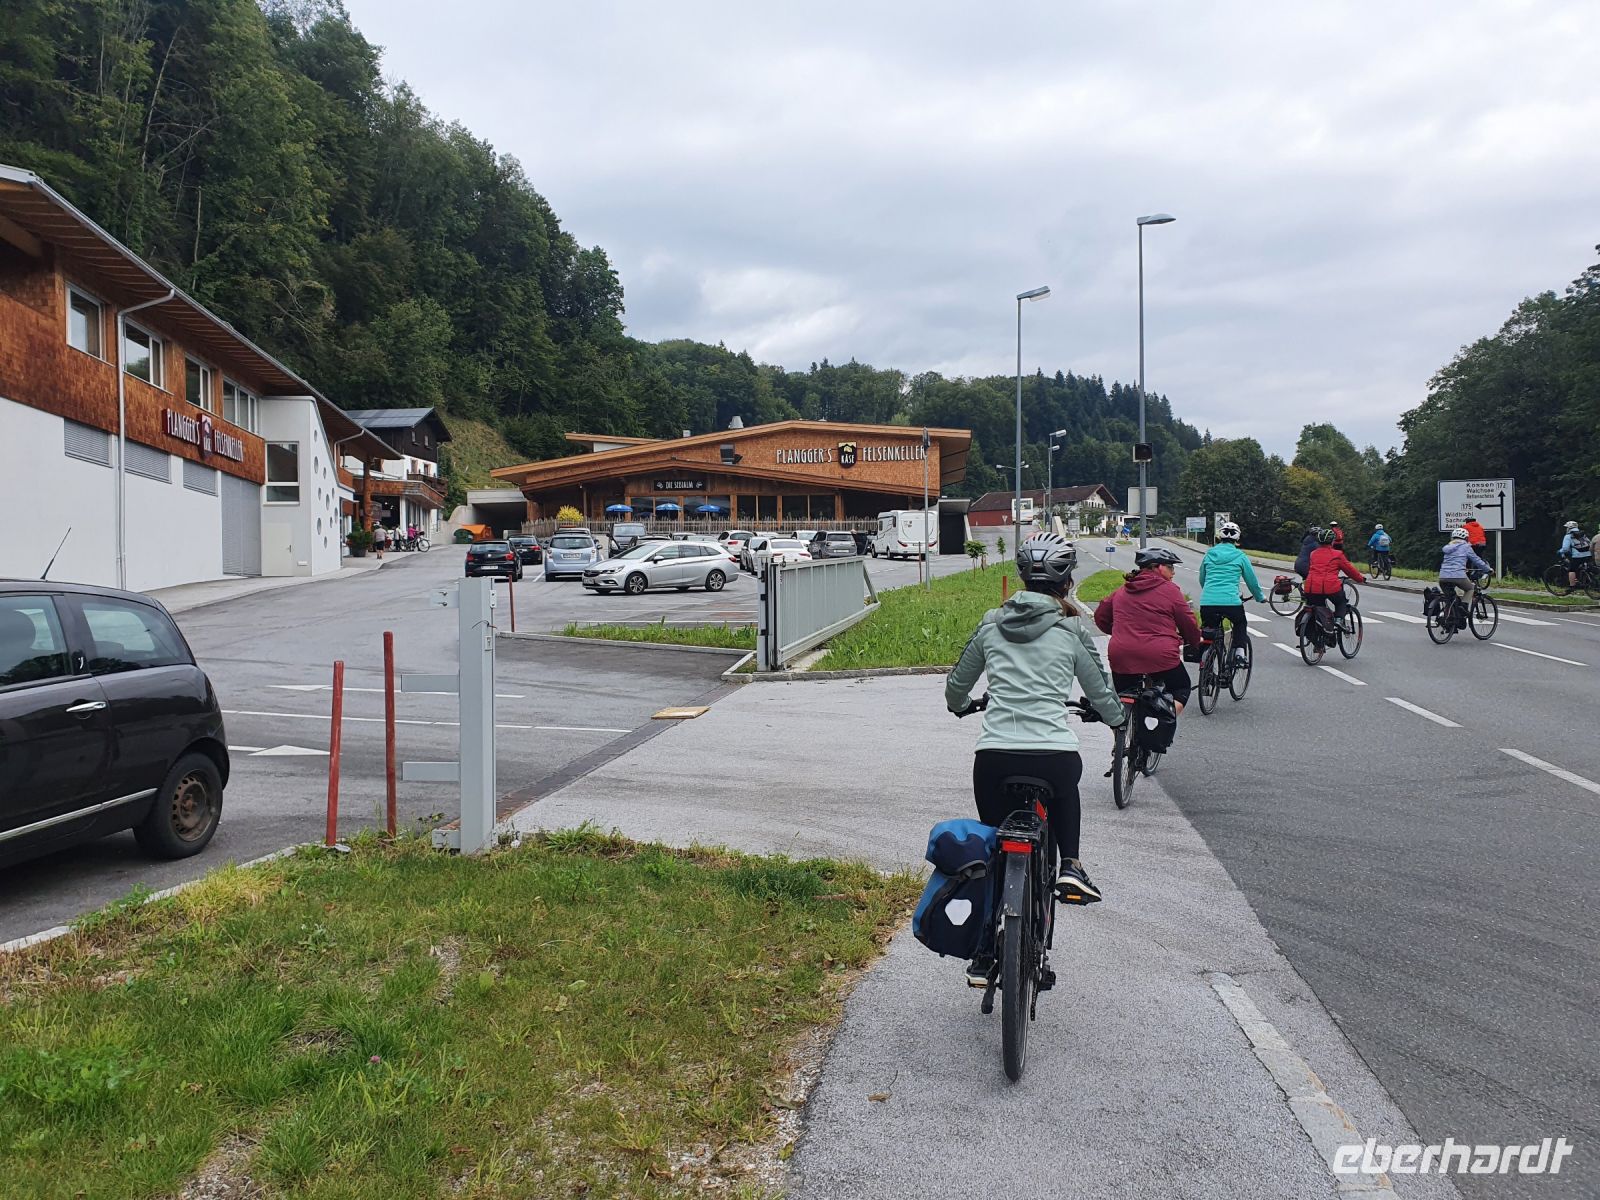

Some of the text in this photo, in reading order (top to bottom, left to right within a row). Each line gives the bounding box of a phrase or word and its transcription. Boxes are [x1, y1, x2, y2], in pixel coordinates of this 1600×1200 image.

[776, 448, 833, 464] PLANGGER'S
[840, 453, 855, 464] KÄSE
[862, 446, 926, 462] FELSENKELLER
